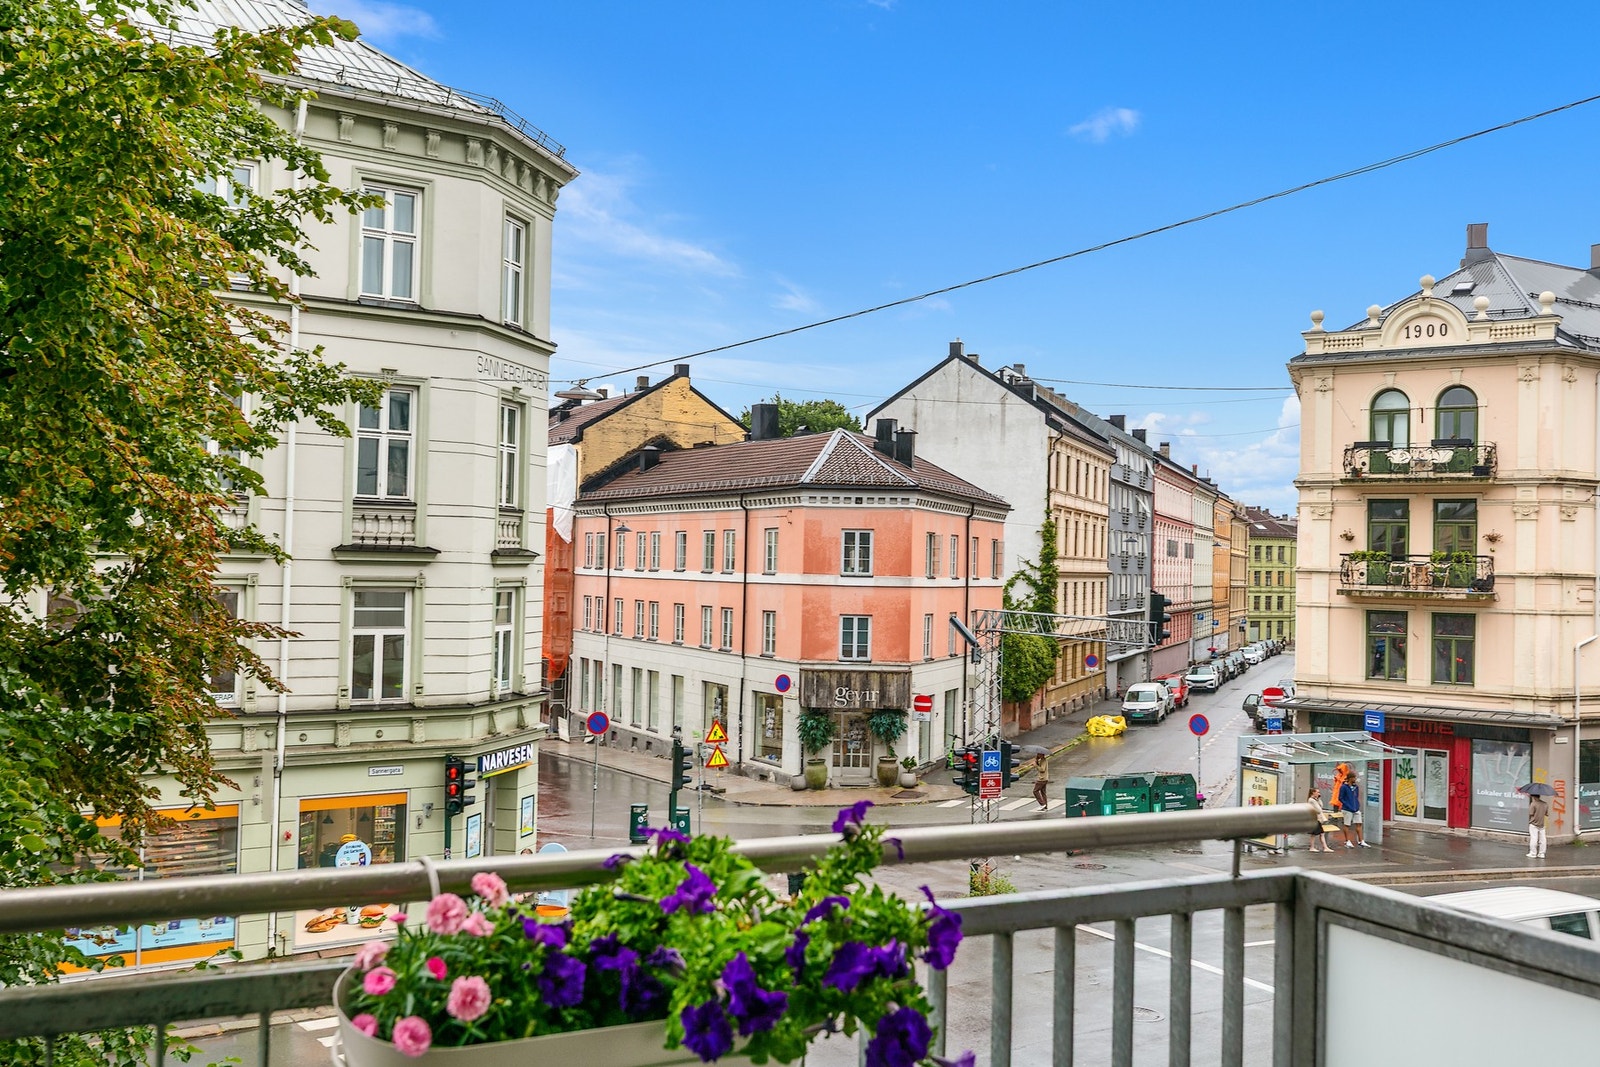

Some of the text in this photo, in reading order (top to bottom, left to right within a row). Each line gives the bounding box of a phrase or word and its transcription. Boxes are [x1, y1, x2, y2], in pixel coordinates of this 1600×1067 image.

[1404, 323, 1448, 339] 1900
[834, 686, 879, 707] gevir
[482, 744, 533, 773] NARVESEN
[1476, 789, 1502, 797] Lokaler
